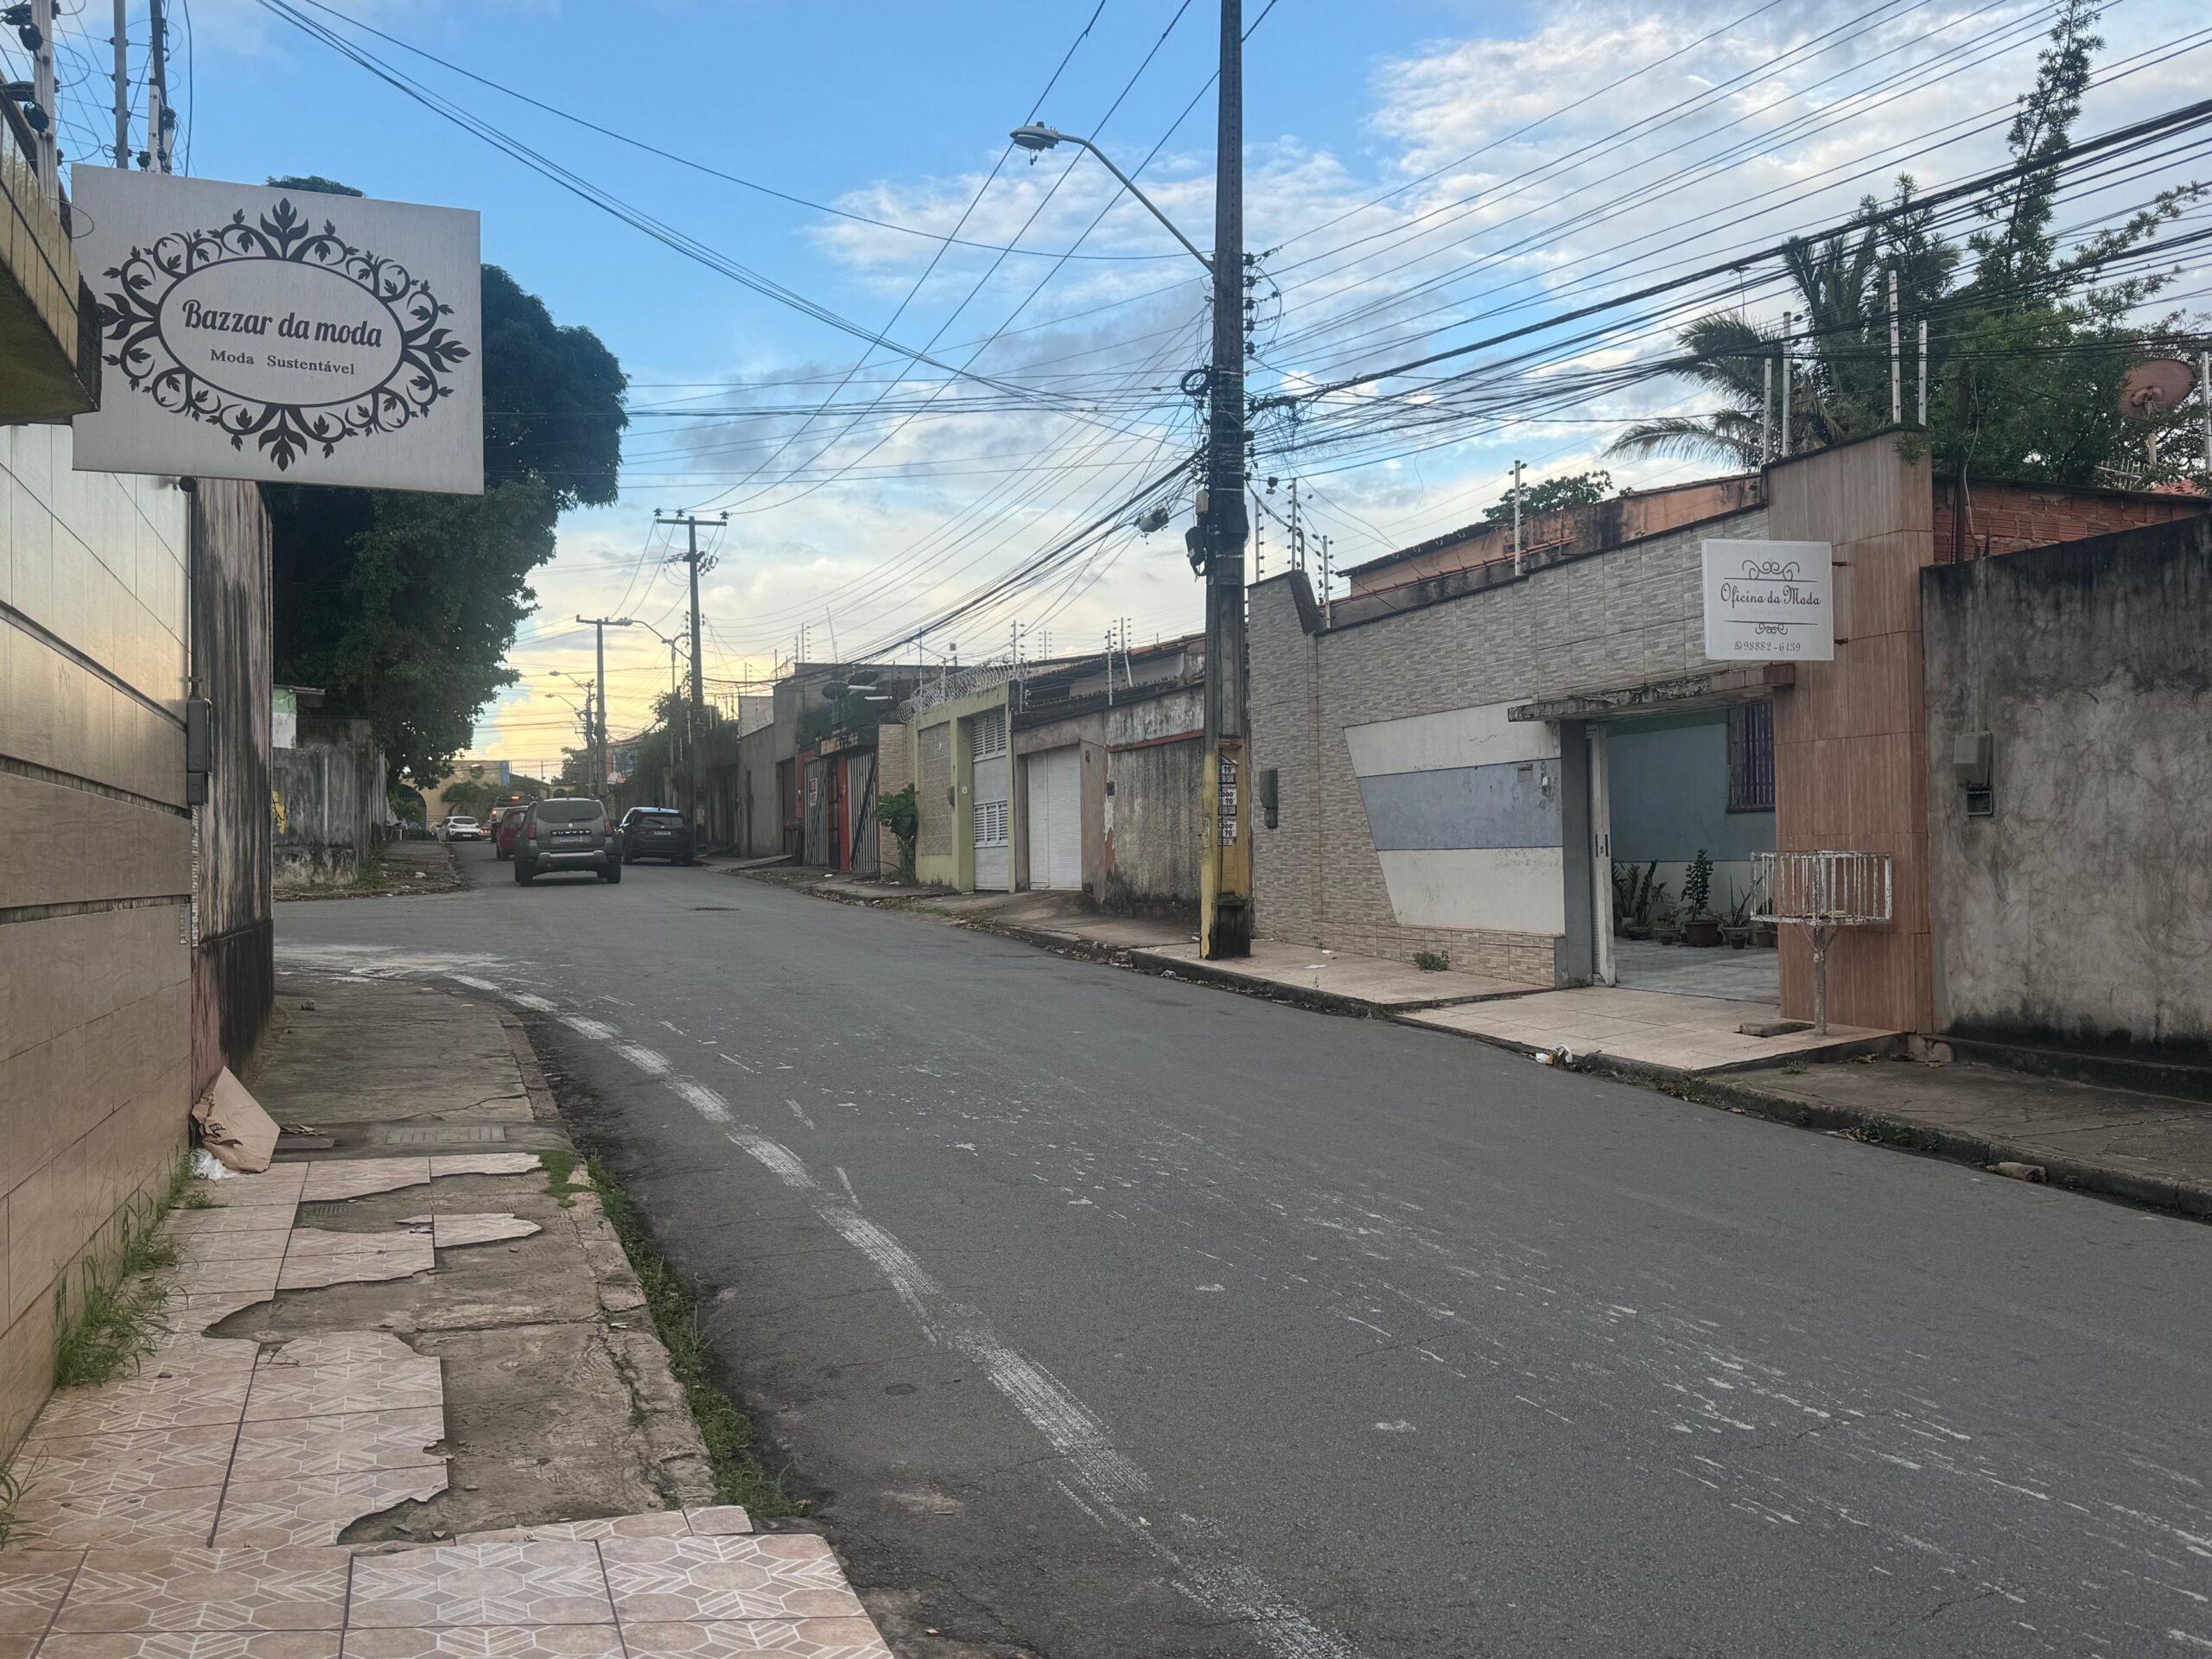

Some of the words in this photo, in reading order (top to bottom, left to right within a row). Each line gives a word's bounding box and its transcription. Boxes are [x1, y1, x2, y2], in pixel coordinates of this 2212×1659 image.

[182, 299, 272, 336] Bazzar
[278, 312, 309, 340] da
[315, 320, 382, 347] moda
[211, 349, 254, 365] Moda
[267, 355, 355, 375] Sustentável
[1720, 582, 1766, 608] Oficina
[1767, 590, 1782, 604] da
[1783, 585, 1821, 605] Moda
